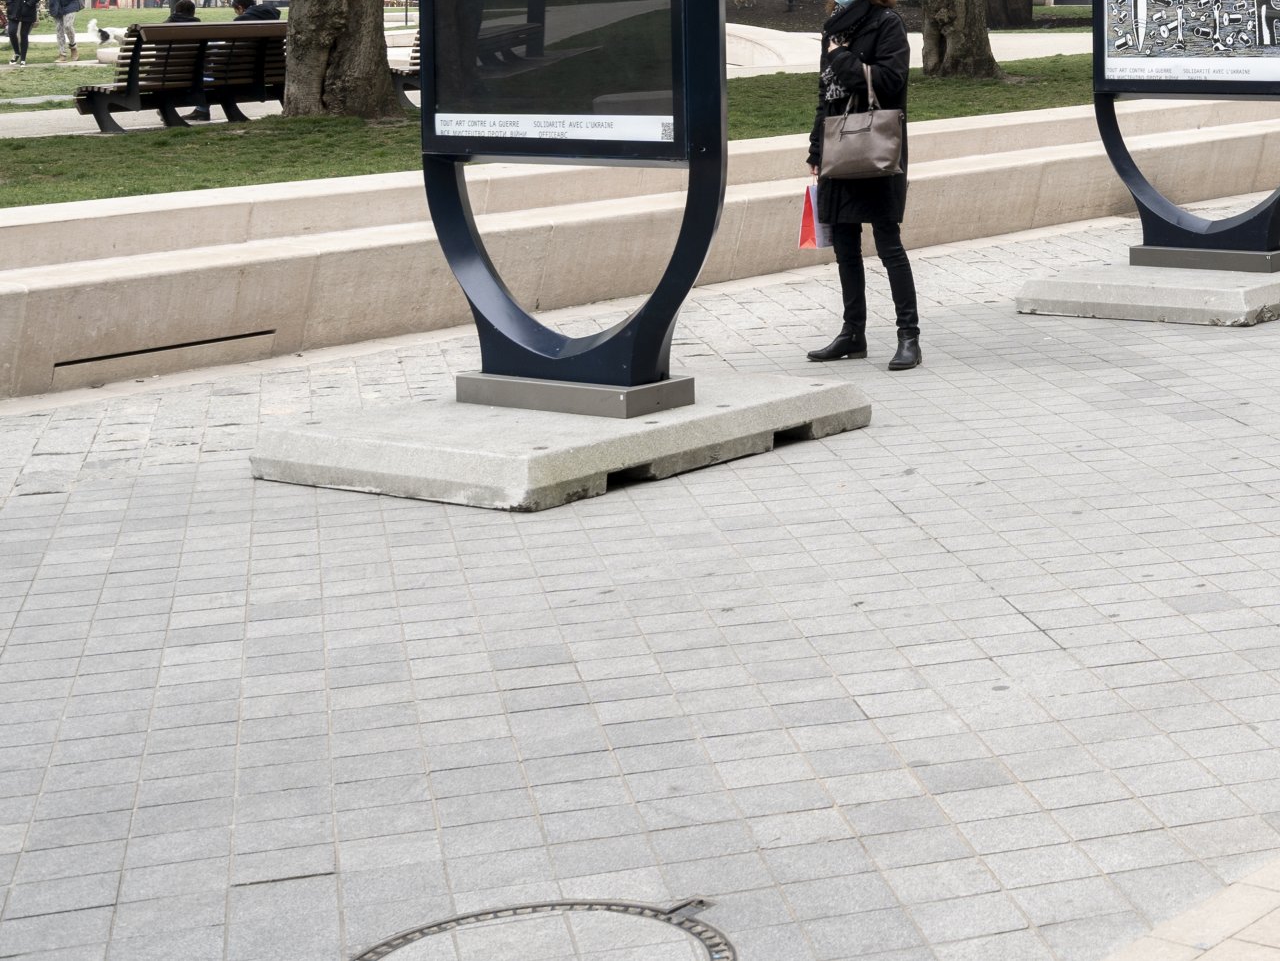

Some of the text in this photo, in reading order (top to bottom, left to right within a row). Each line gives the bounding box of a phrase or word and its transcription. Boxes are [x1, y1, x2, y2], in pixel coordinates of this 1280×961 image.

[440, 119, 614, 130] TOUT ART CONTRE LA GUERRE SOLIDARITÉ AVEC L'UKRAINE
